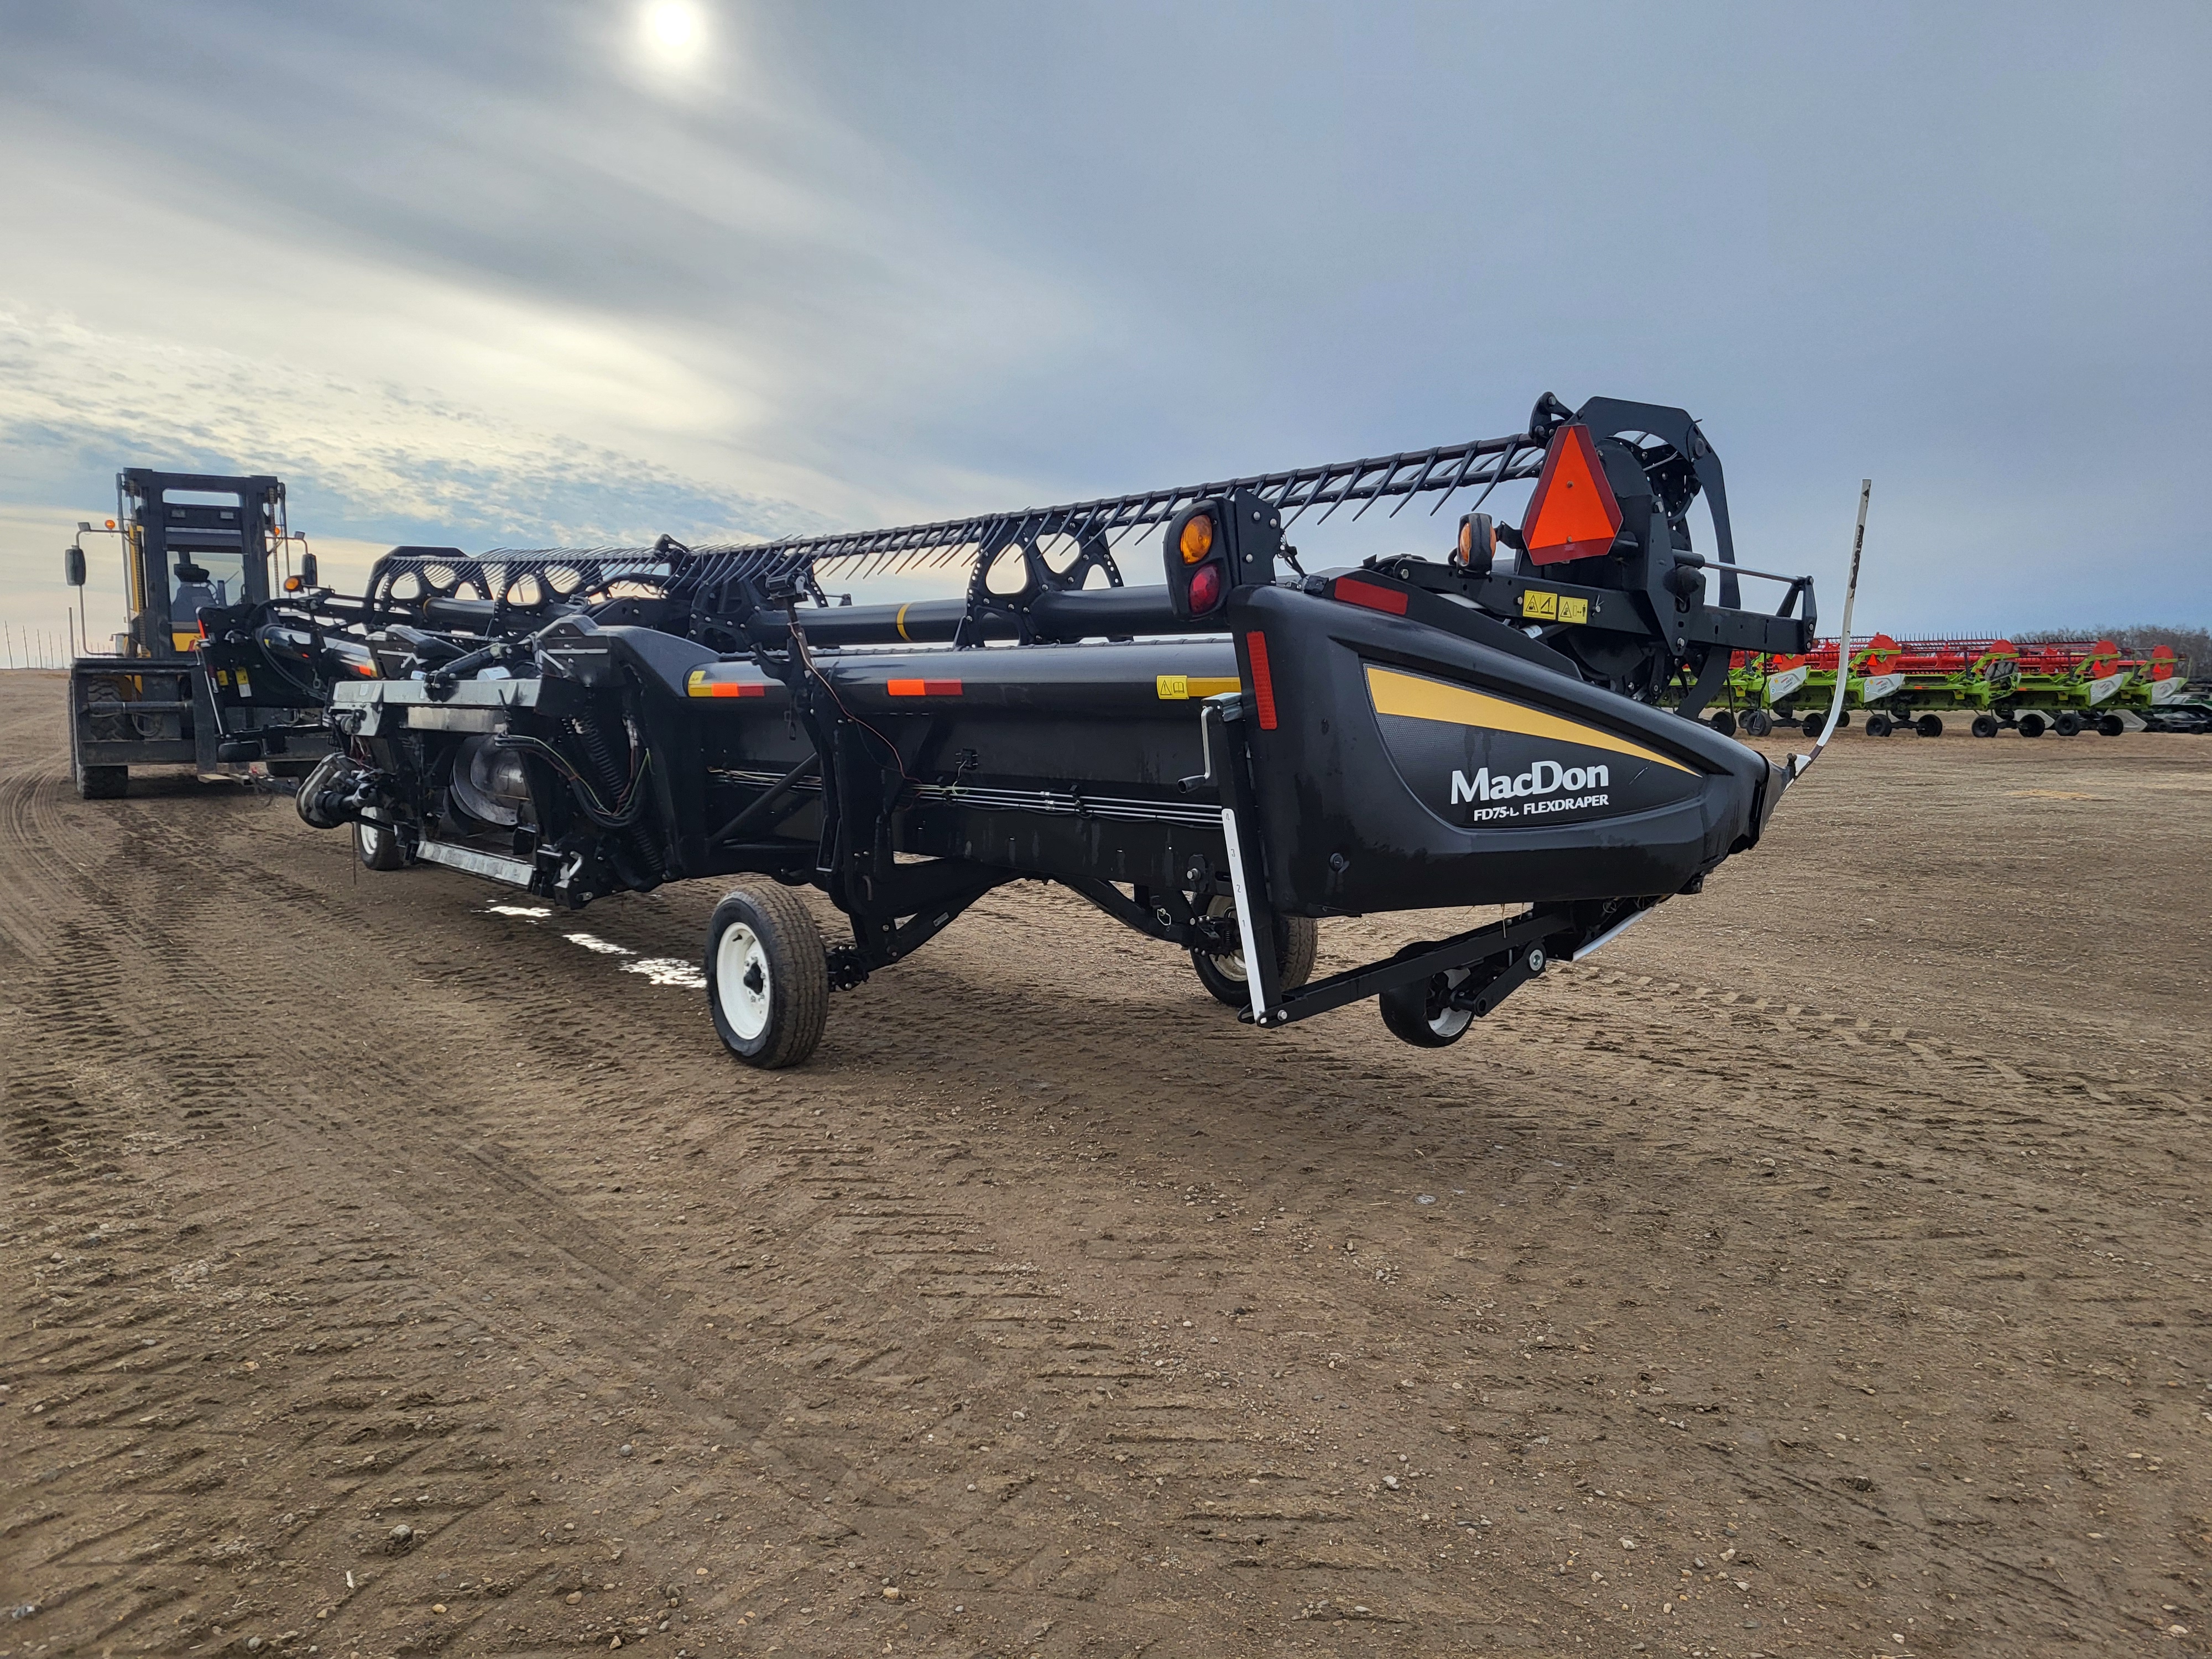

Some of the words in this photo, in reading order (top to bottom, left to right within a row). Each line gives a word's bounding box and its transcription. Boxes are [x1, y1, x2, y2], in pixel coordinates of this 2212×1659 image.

[1451, 761, 1609, 804] MacDon
[1524, 795, 1609, 815] FLEXDRAPER
[1225, 813, 1230, 821] 4
[1230, 848, 1236, 858] 3
[1236, 884, 1241, 893] 2
